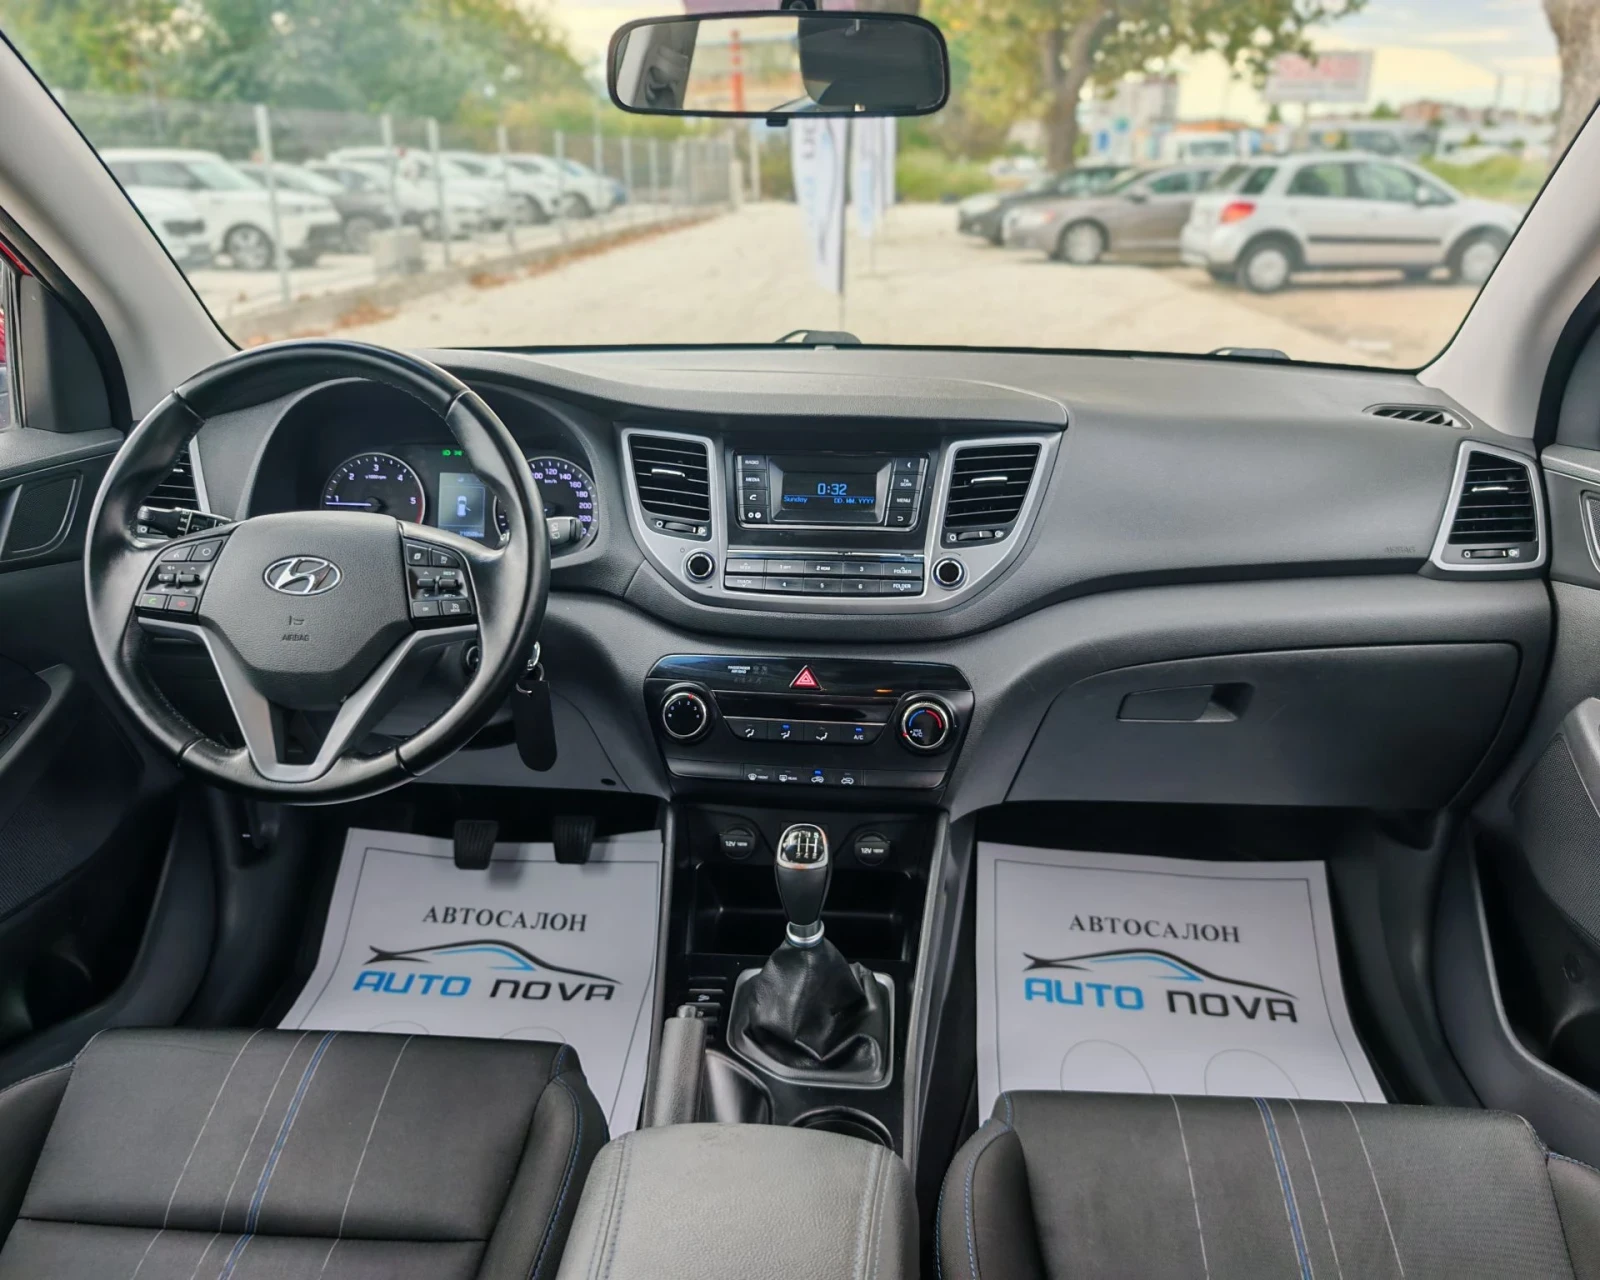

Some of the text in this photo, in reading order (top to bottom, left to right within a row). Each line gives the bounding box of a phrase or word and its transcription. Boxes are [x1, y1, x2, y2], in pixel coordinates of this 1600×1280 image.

[576, 490, 589, 498] 180
[817, 483, 847, 496] 0:32
[409, 497, 417, 505] 5
[578, 502, 592, 510] 200
[783, 496, 808, 504] Sunday
[422, 905, 588, 932] АВТОСАЛОН
[1069, 914, 1241, 943] АВТОСАЛОН
[352, 970, 615, 1002] AUTO NOVA
[1024, 977, 1299, 1023] AUTO NOVA
